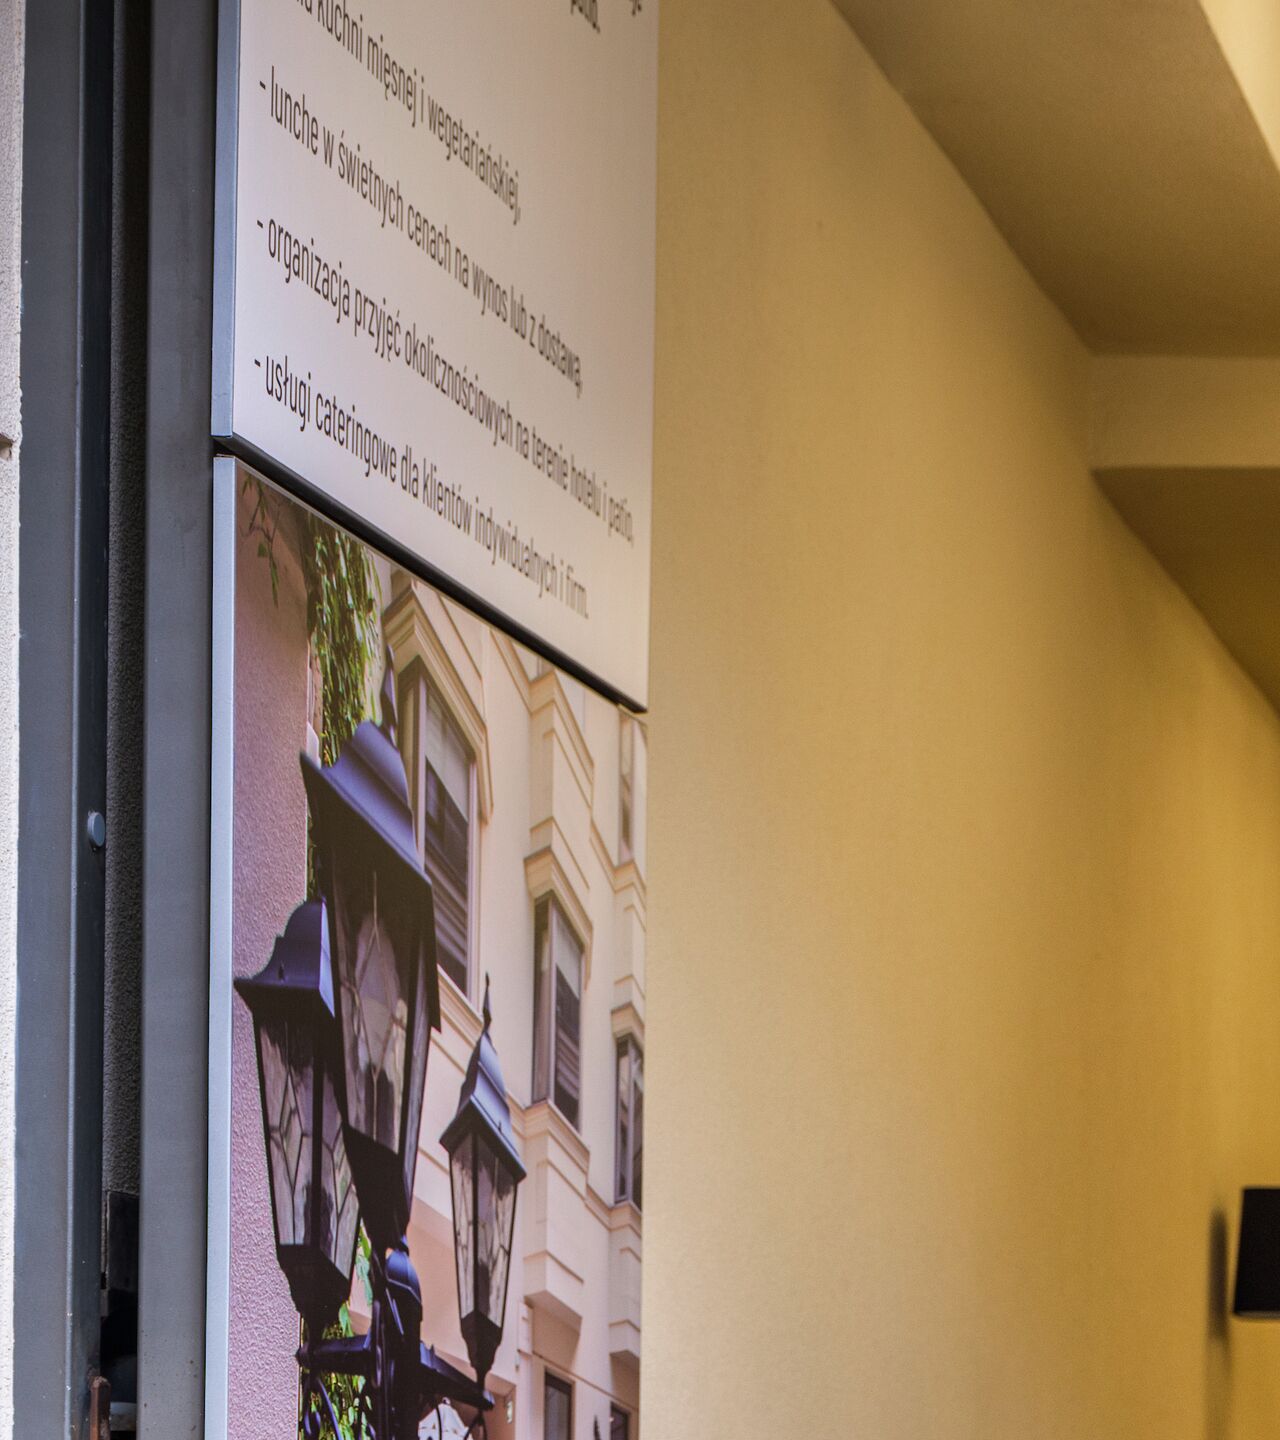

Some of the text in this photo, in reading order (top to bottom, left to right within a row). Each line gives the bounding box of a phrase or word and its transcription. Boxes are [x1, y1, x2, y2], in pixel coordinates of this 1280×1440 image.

[270, 65, 319, 156] lunche
[323, 126, 335, 168] w
[338, 130, 404, 232] świetnych
[407, 204, 451, 274] cenach
[455, 246, 469, 290] na
[472, 261, 508, 323] wynos
[510, 285, 527, 340] lub
[529, 314, 536, 348] z
[367, 34, 417, 128] mięsnej
[420, 75, 426, 123] i
[427, 95, 521, 226] wegetariańskiej,
[266, 355, 312, 432] usługi
[315, 393, 397, 482] cateringowe
[400, 445, 419, 500] dla
[423, 457, 472, 535] klientów
[475, 496, 558, 599] indywidualnych
[268, 218, 350, 324] organizacja
[354, 287, 401, 362] przyjęć
[404, 323, 513, 447] okolicznościowych
[516, 421, 529, 460] na
[532, 426, 568, 490] terenie
